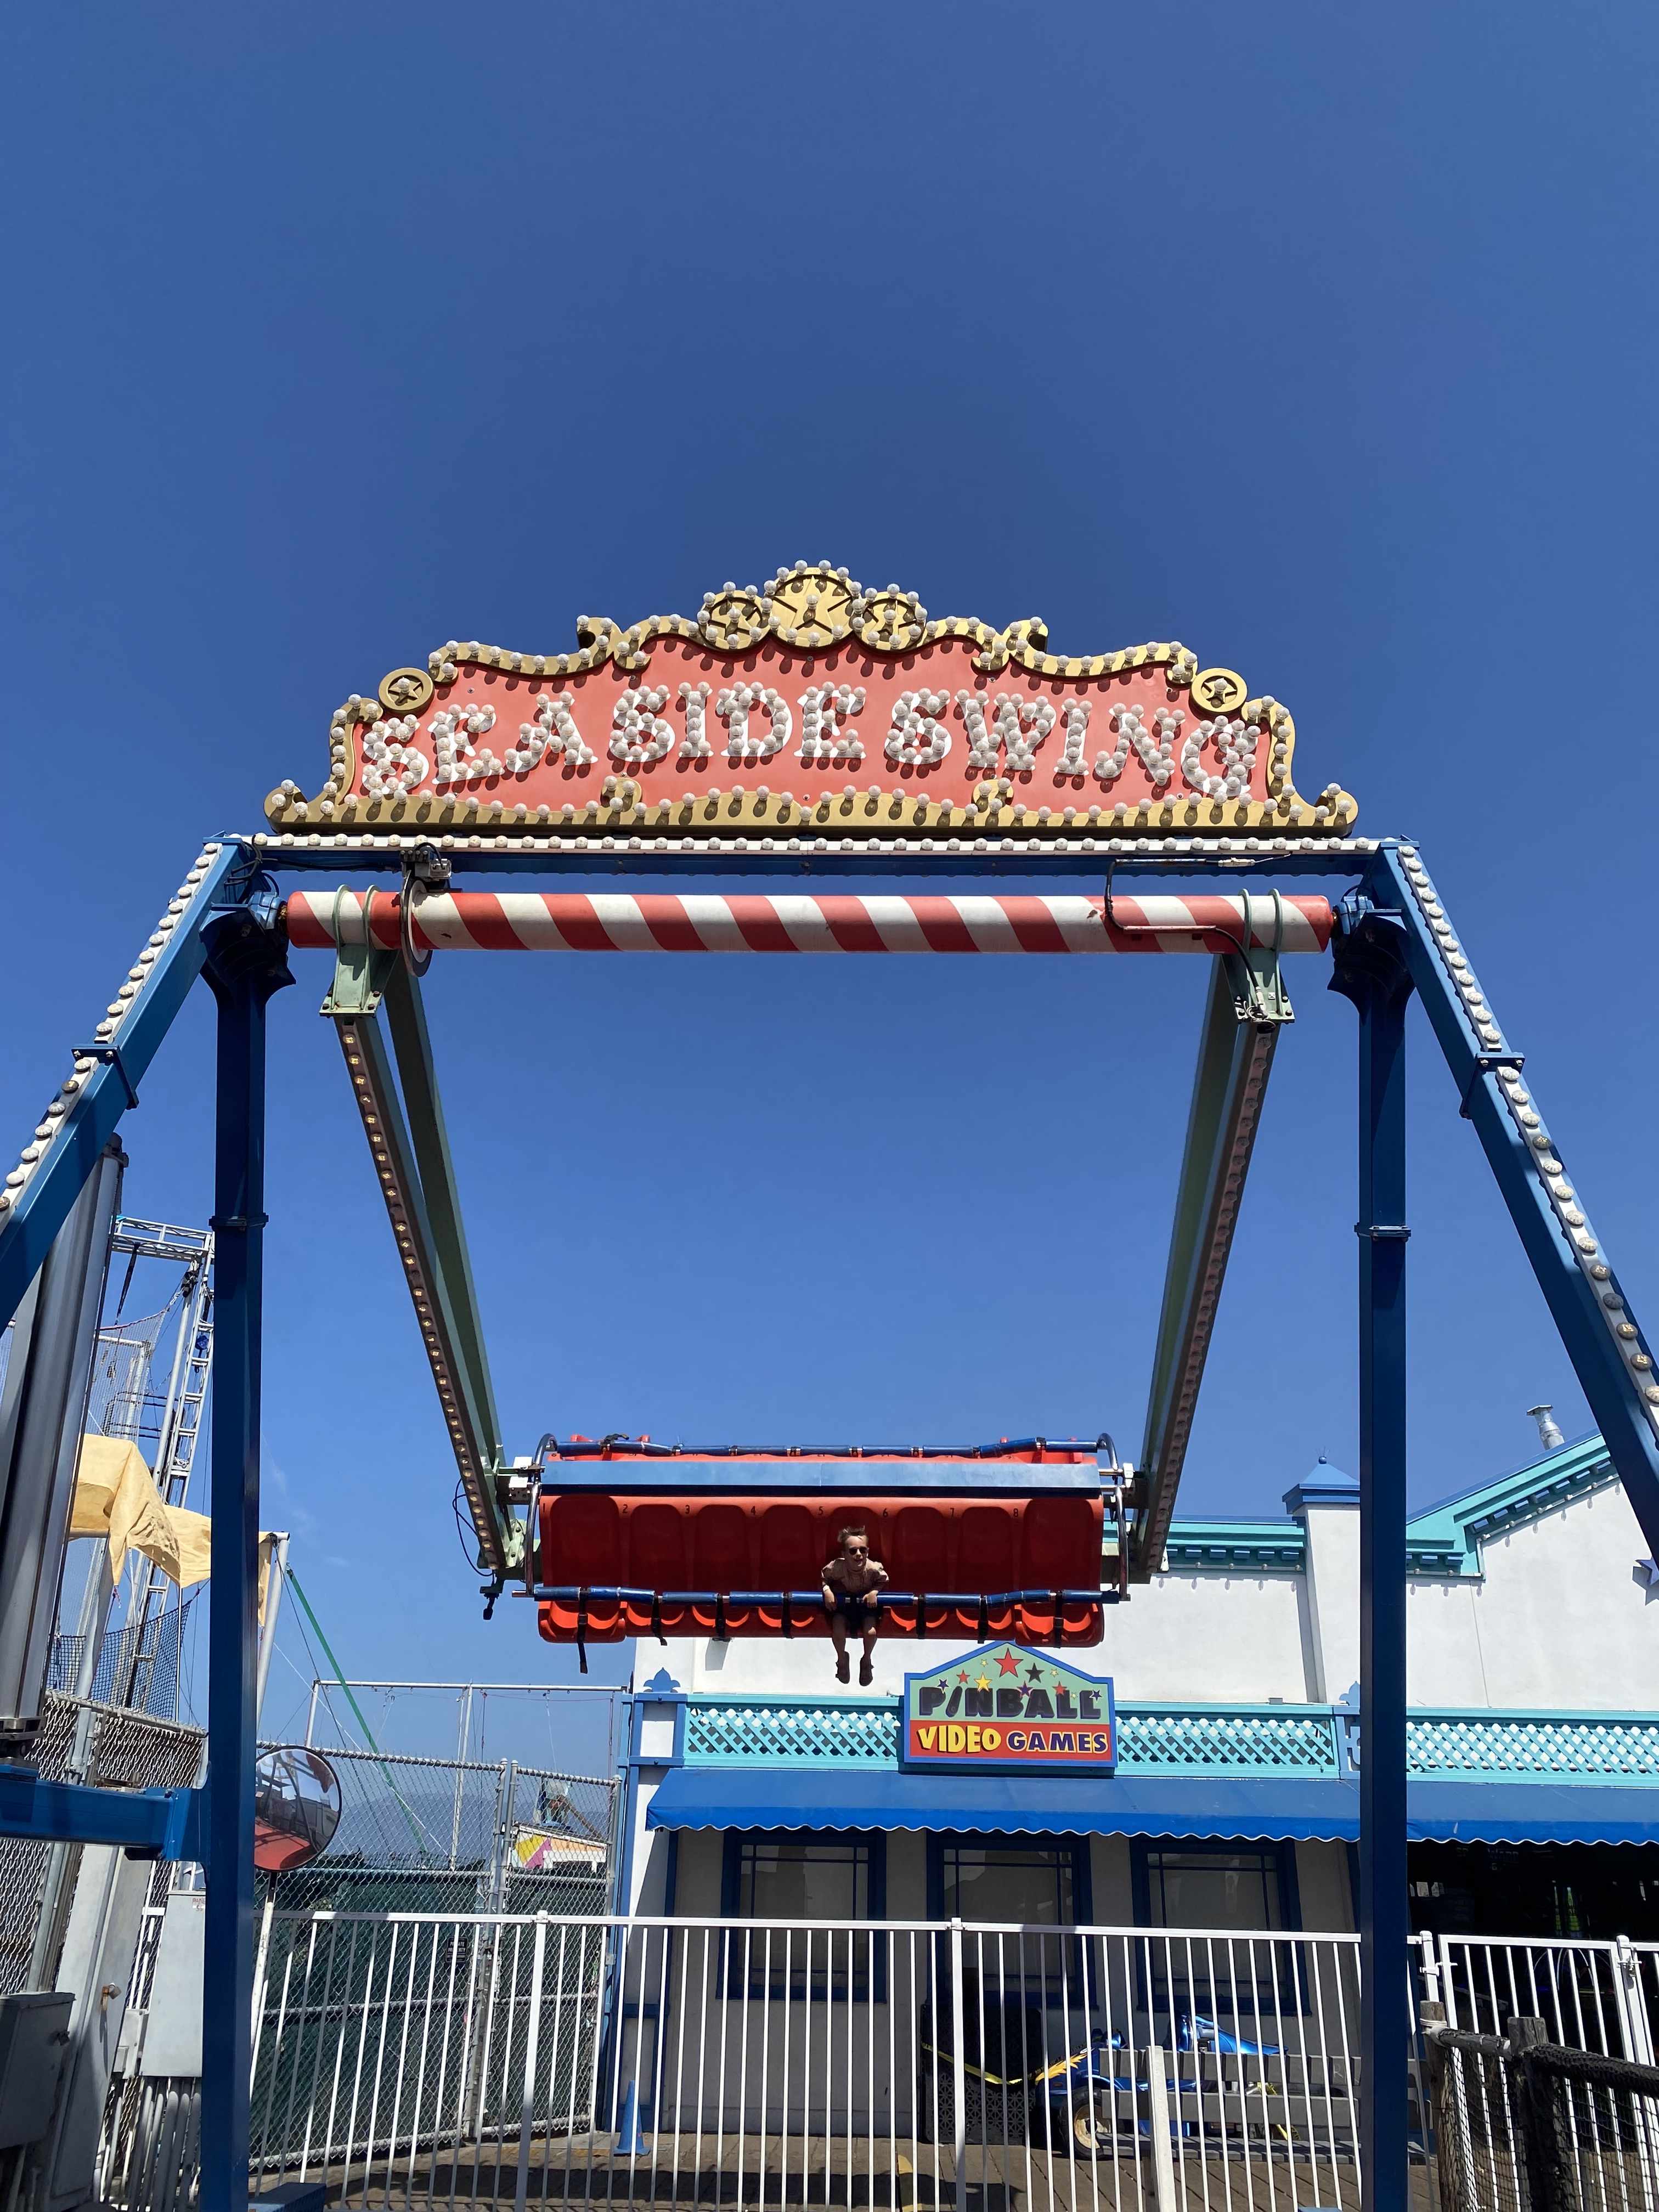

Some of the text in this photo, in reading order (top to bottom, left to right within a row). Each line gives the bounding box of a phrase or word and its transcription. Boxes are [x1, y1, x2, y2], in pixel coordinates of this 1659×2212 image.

[884, 688, 1260, 796] SWING
[622, 1504, 628, 1514] 2
[685, 1504, 690, 1514] 3
[750, 1506, 756, 1515] 4
[818, 1506, 823, 1515] 5
[883, 1508, 889, 1517] 6
[950, 1508, 955, 1517] 7
[1013, 1508, 1019, 1517] 8
[919, 1685, 1102, 1719] PINBALL
[917, 1724, 1109, 1754] VIDEO GAMES
